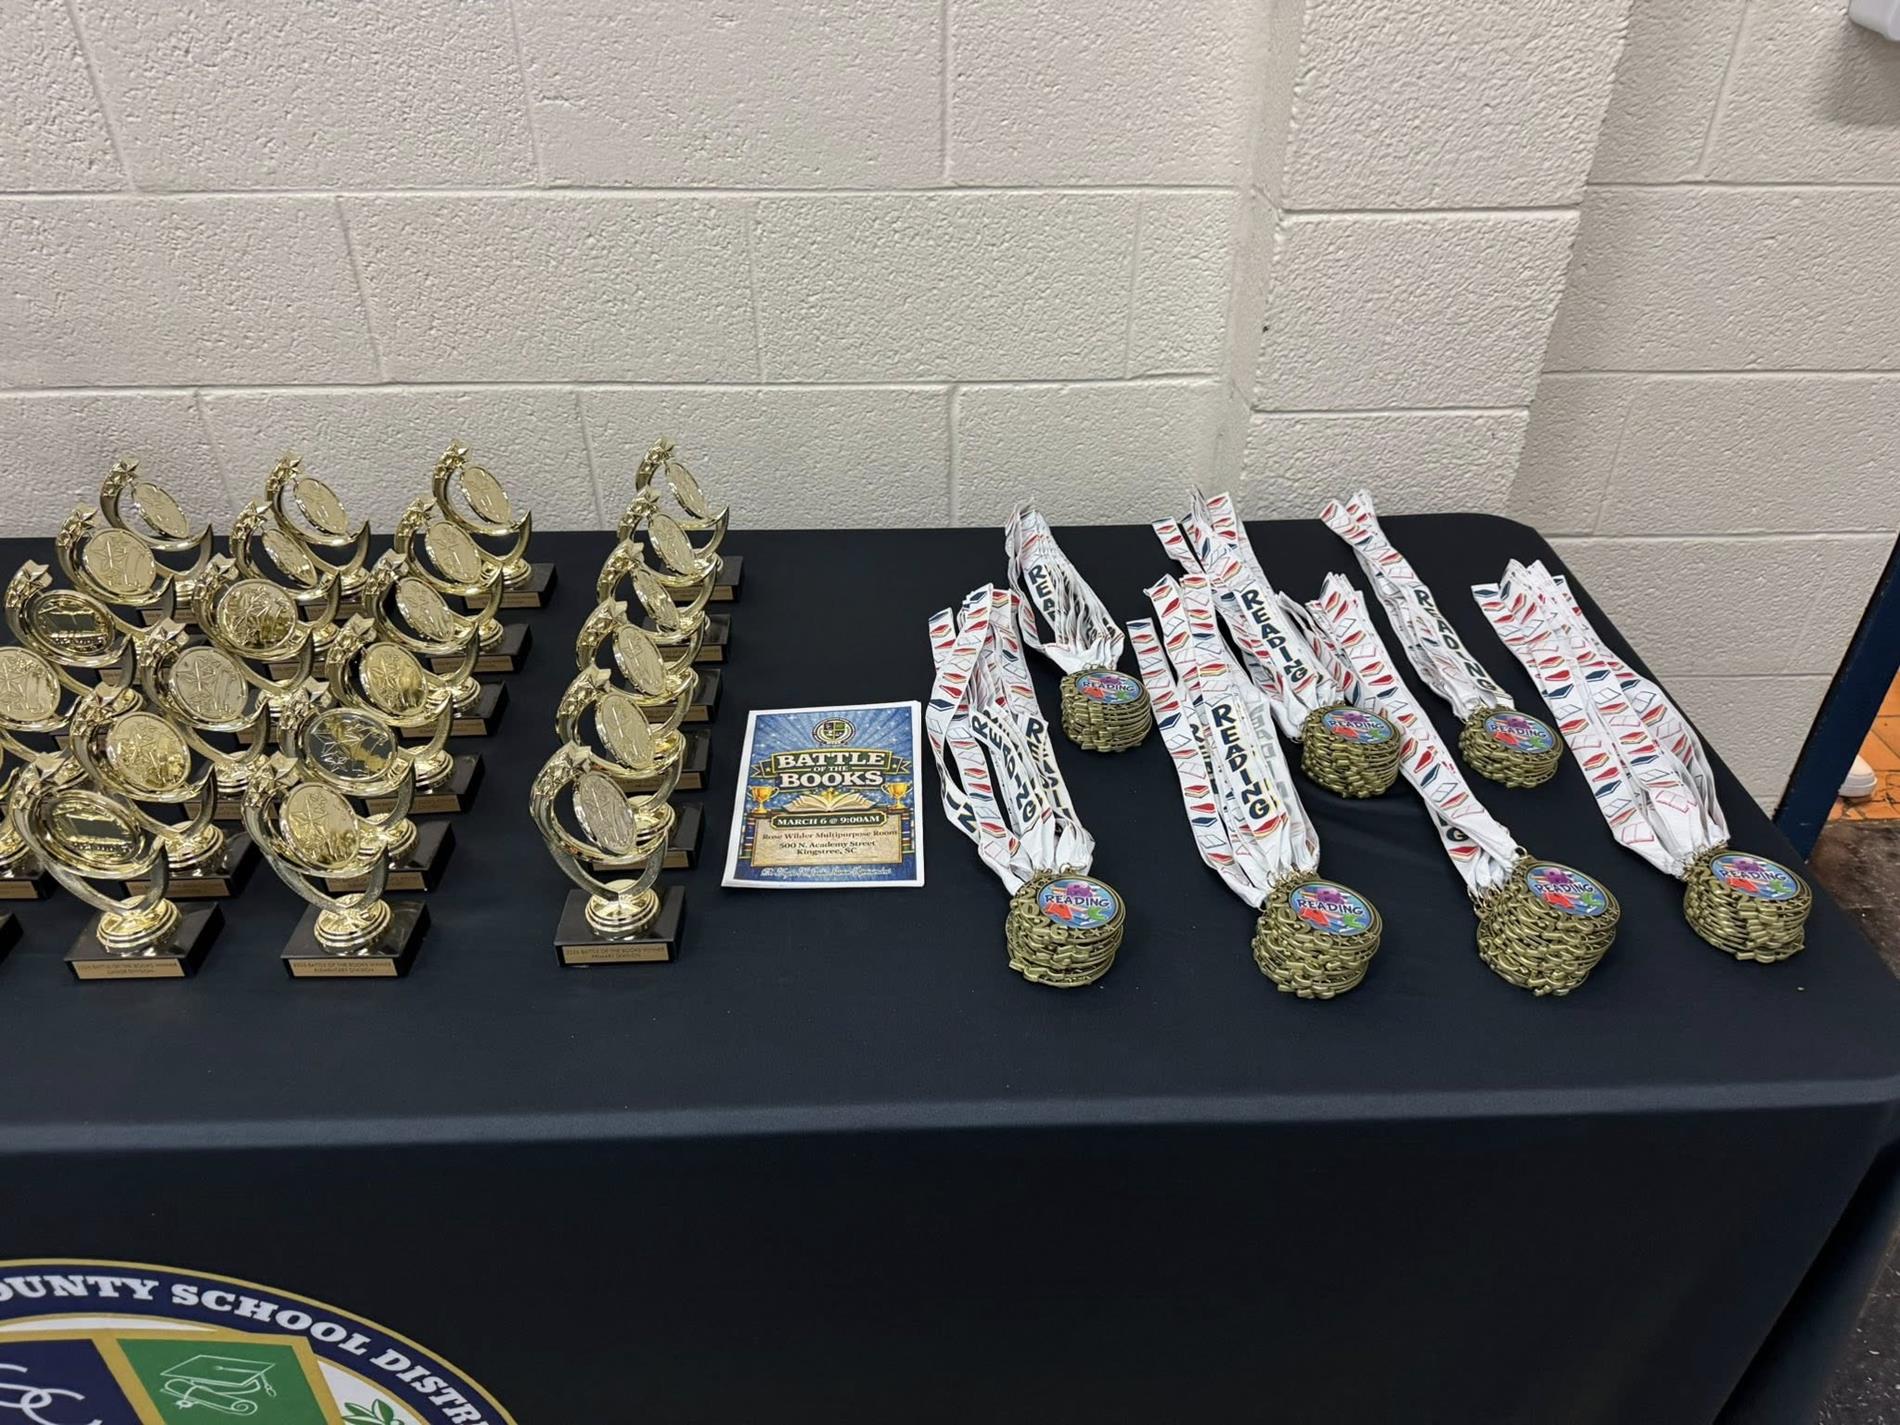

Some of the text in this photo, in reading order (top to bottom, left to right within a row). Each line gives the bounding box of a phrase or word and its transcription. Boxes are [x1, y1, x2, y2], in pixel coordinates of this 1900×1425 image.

[1241, 589, 1308, 683] READING
[1082, 681, 1135, 692] READING
[1328, 720, 1384, 730] READING
[1490, 724, 1547, 738] READING
[777, 752, 886, 769] BATTLE
[1211, 703, 1270, 820] READING
[971, 715, 1036, 823] READING
[779, 770, 884, 788] BOOKS
[777, 818, 817, 826] MARCH
[820, 817, 827, 825] 6
[840, 815, 880, 824] 9:00AM
[784, 832, 813, 840] Wilder
[815, 831, 872, 840] Multipurpose
[796, 848, 843, 856] Kingstree,
[809, 841, 848, 849] Academy
[1719, 869, 1787, 881] READING
[1534, 883, 1594, 894] READING
[1044, 894, 1111, 908] READING
[1296, 899, 1364, 915] READING
[171, 1284, 374, 1356] SCHOOL
[369, 1348, 489, 1425] DISTR
